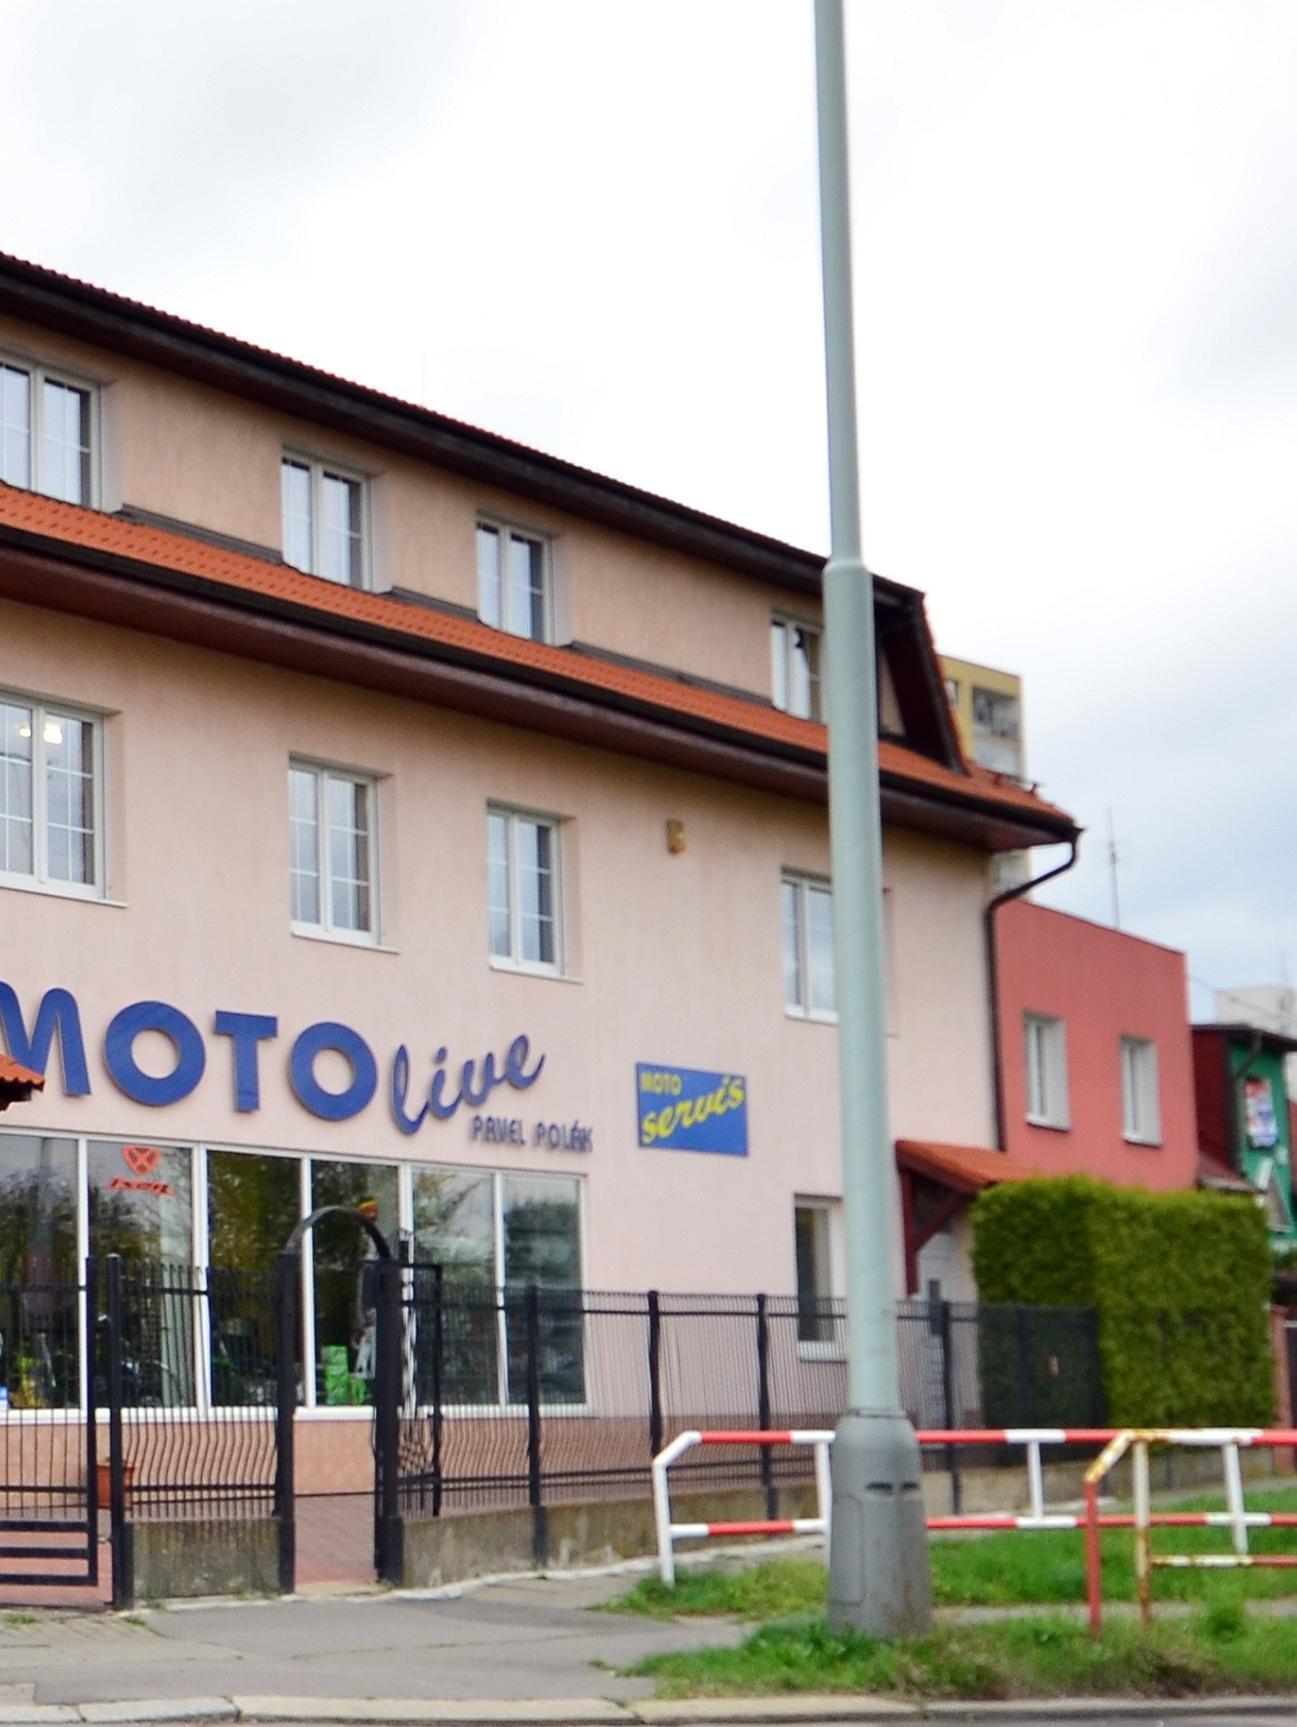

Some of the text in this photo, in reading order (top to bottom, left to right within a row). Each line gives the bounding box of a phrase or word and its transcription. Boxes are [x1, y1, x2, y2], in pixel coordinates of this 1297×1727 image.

[392, 1033, 546, 1136] live
[642, 1075, 745, 1144] servis
[472, 1115, 593, 1152] PAVEL POLÁK
